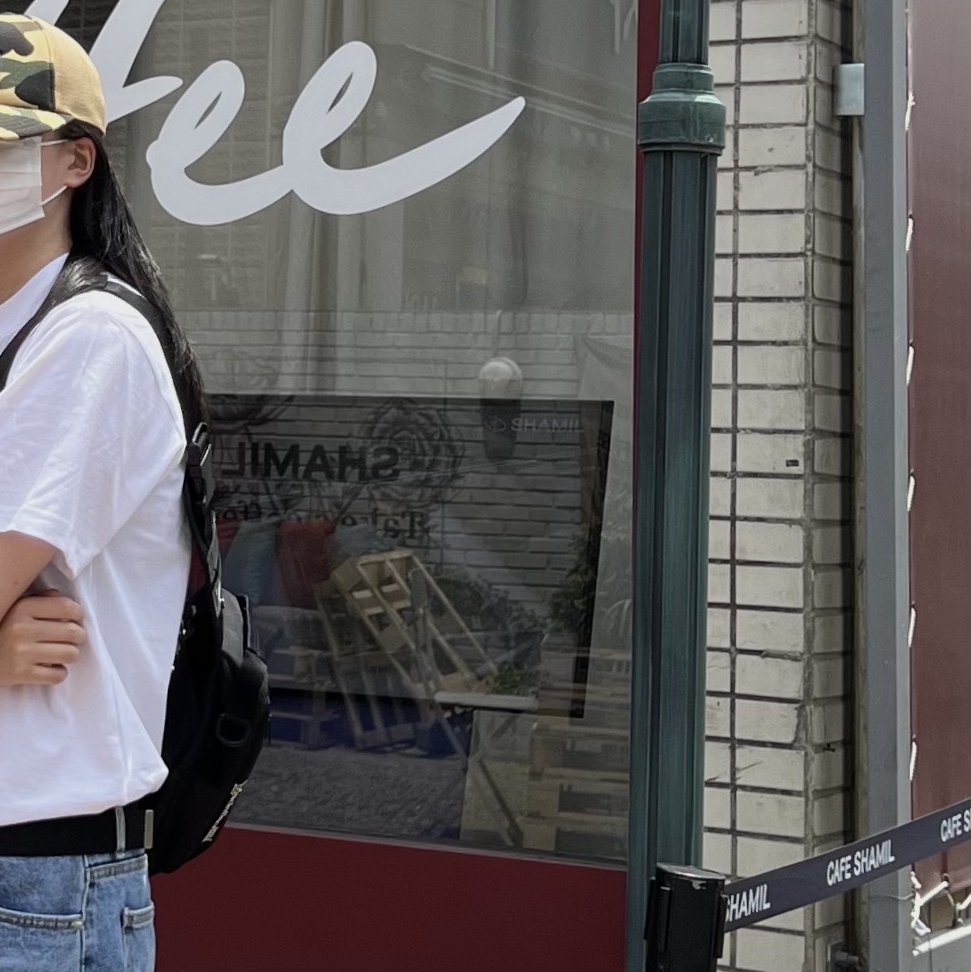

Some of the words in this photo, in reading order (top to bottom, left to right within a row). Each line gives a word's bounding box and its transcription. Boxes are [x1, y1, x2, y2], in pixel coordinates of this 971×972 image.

[511, 417, 584, 433] SHAMIL
[940, 813, 962, 842] CAFE
[827, 855, 852, 886] CAFE
[854, 839, 895, 876] SHAMIL
